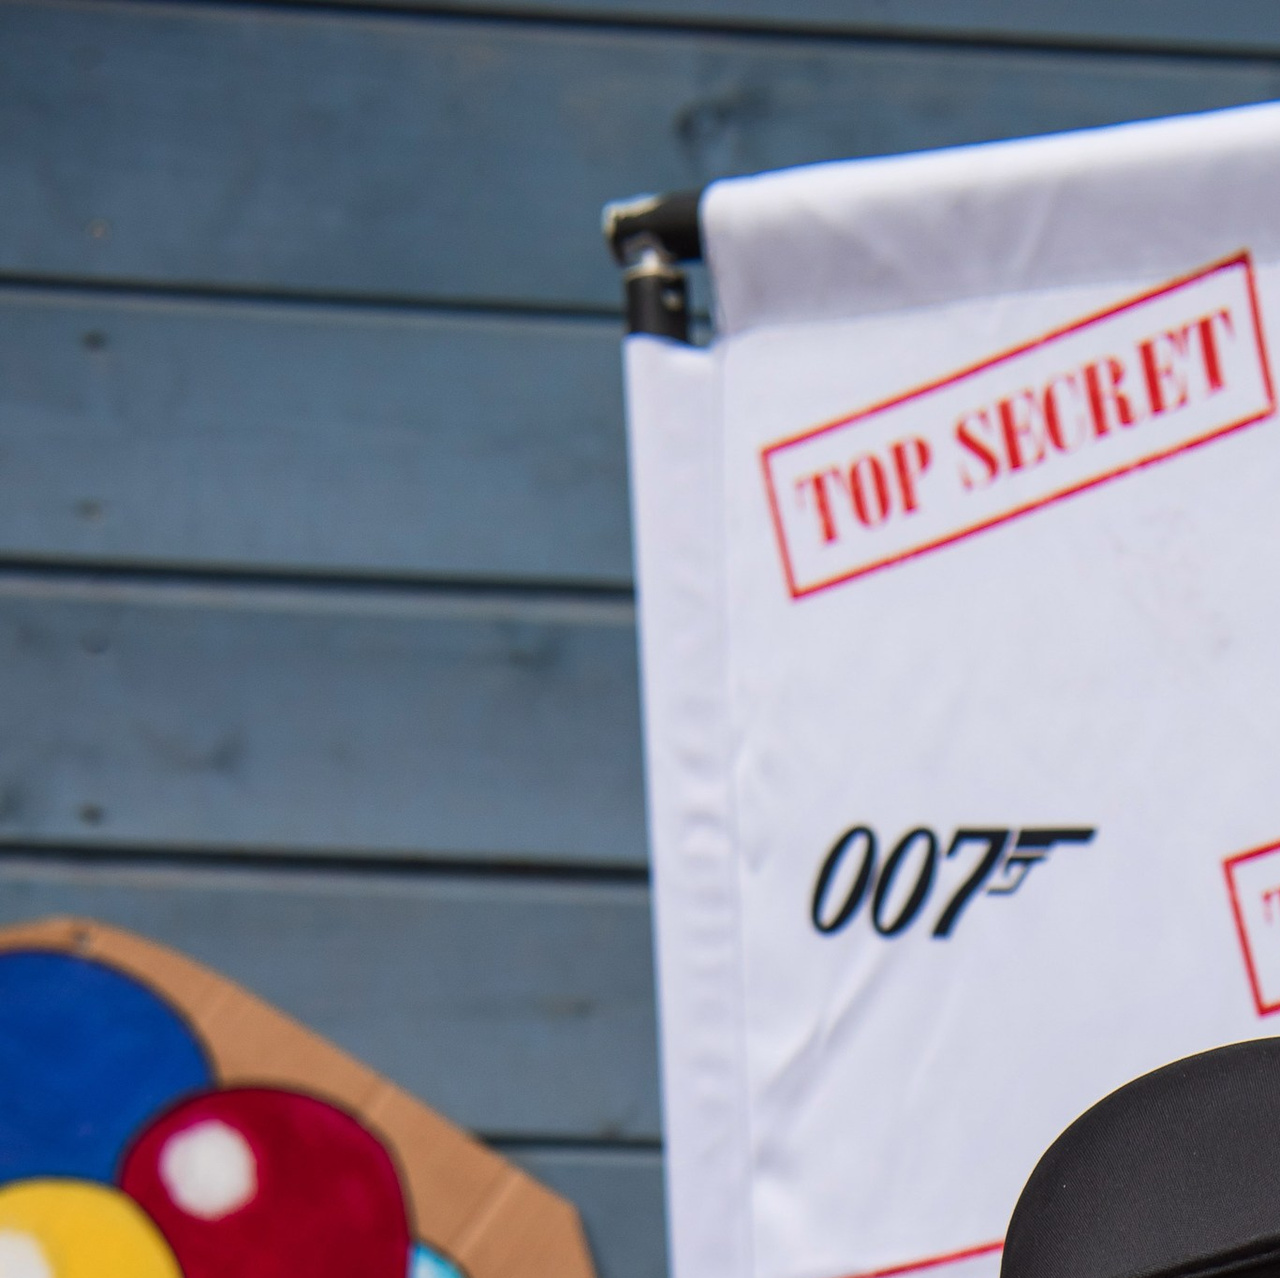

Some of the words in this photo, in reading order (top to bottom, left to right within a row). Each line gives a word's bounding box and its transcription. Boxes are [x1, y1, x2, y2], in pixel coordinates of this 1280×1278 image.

[794, 435, 934, 546] TOP
[952, 307, 1234, 492] SECRET
[810, 825, 1012, 939] 007
